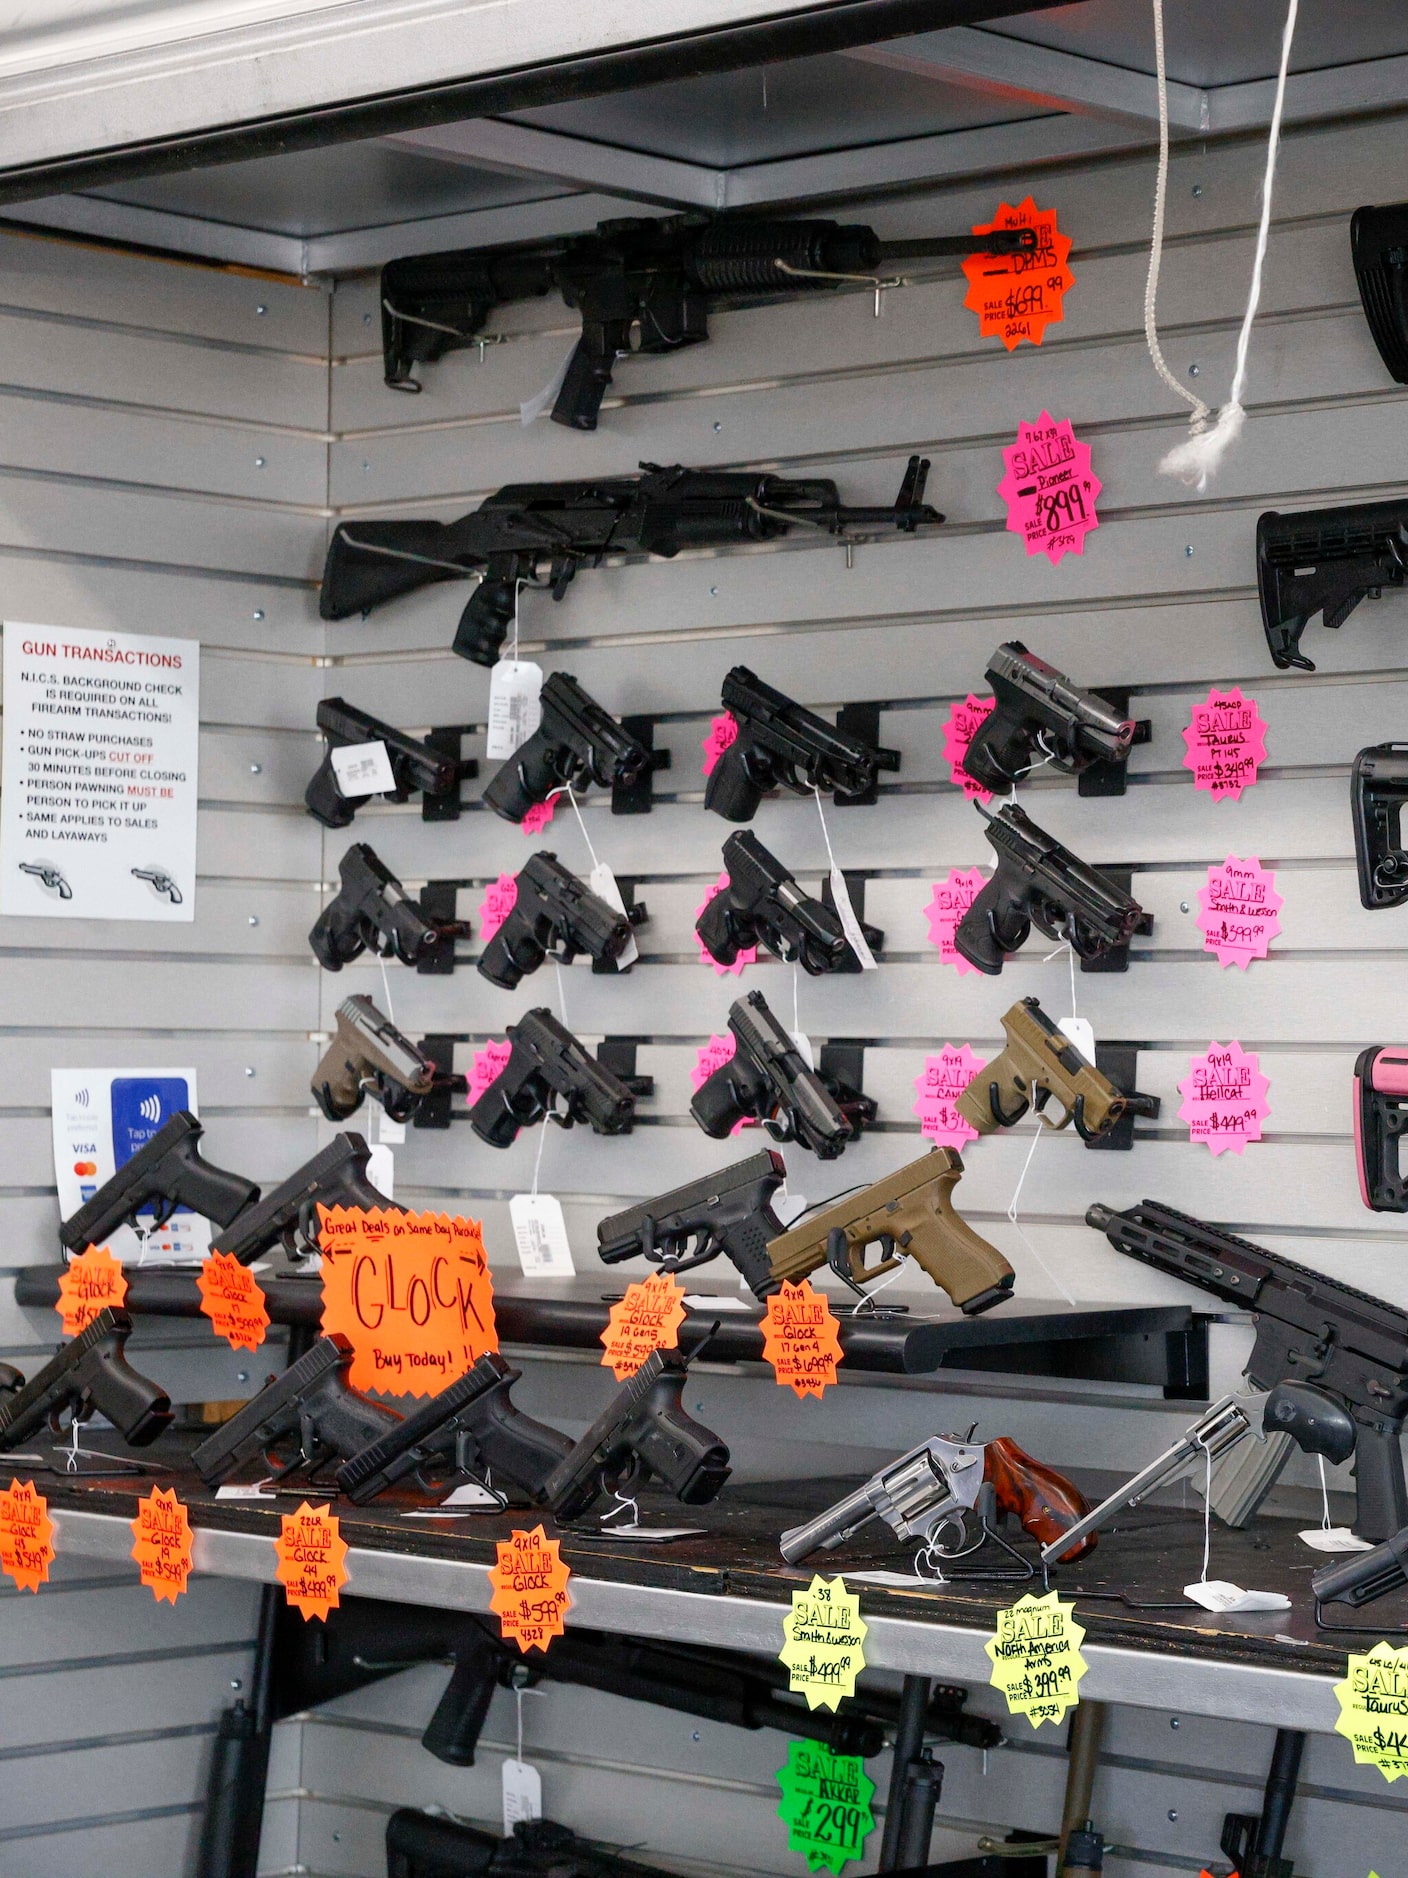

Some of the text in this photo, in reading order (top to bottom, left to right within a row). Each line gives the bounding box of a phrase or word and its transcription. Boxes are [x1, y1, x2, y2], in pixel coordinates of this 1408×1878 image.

[1012, 434, 1075, 480] SALE
[23, 641, 182, 669] GUN TRANSACTIONS
[22, 673, 182, 694] N.I.C.S. BACKGROUND CHECK
[46, 689, 158, 707] IS REQUIRED ON ALL
[32, 704, 172, 723] FIREARM TRANSACTIONS!
[28, 729, 153, 747] NO STRAW PURCHASES
[28, 746, 154, 764] GUN PICK-UPS CUT OFF
[28, 763, 186, 782] 30 MINUTES BEFORE CLOSING
[27, 779, 174, 798] PERSON PAWNING MUST BE
[27, 796, 147, 811] PERSON TO PICK IT UP
[26, 813, 157, 829] SAME APPLIES TO SALES
[25, 829, 108, 842] AND LAYAWAYS
[73, 1144, 96, 1153] VISA
[325, 1218, 356, 1234] Great
[772, 1303, 824, 1325] SALE
[373, 1348, 402, 1374] Buy
[501, 1552, 552, 1575] SALE
[795, 1602, 850, 1629] SALE
[1001, 1613, 1064, 1643] SALE
